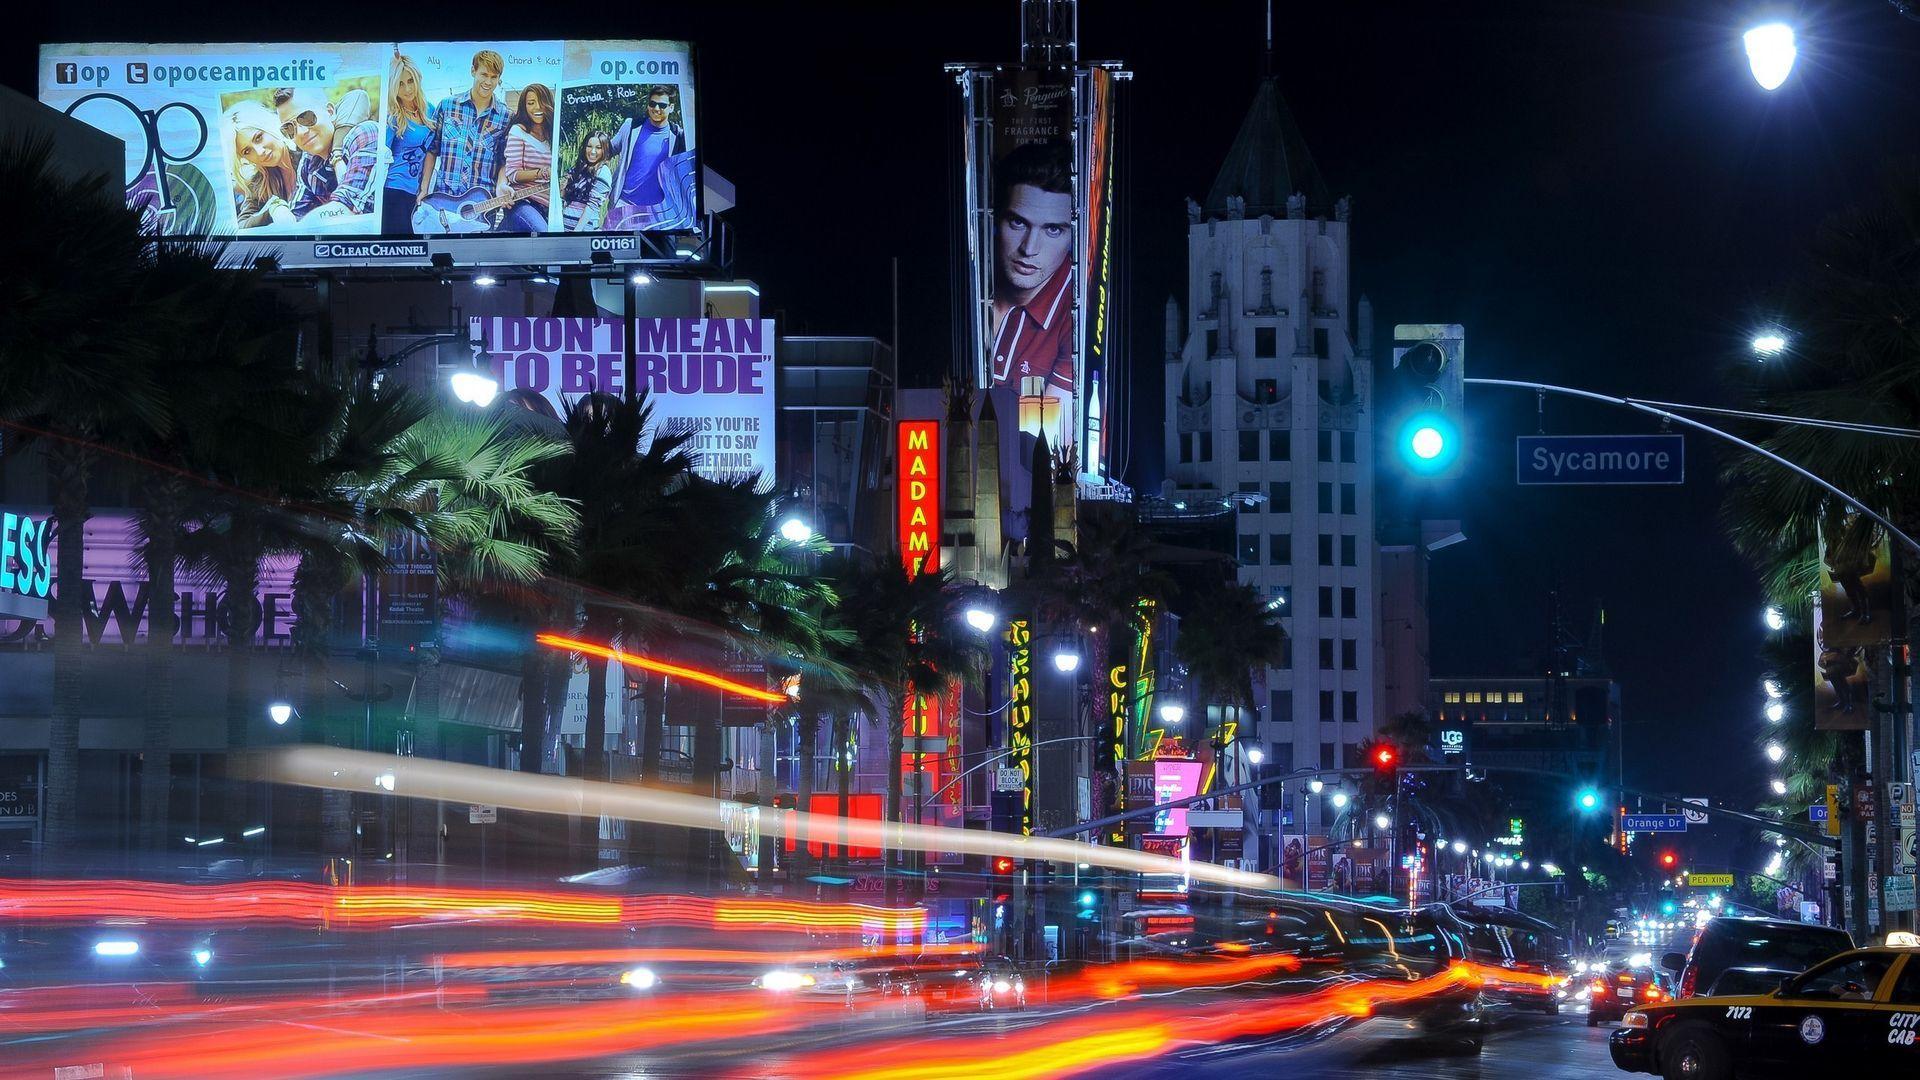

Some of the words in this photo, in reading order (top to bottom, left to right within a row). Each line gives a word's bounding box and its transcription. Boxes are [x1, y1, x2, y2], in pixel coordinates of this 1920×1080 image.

[427, 55, 442, 69] Aly
[508, 54, 533, 65] Chord
[153, 60, 326, 87] opoceanpacific
[600, 58, 680, 80] op.com
[81, 66, 110, 87] op
[566, 92, 604, 105] Brenda
[616, 87, 636, 99] Rob
[1023, 86, 1069, 105] Penguin
[1004, 126, 1059, 135] FRAGRANCE
[591, 238, 635, 249] 001161
[502, 317, 625, 352] DON'T
[638, 318, 763, 353] MEAN
[561, 353, 625, 394] BE
[715, 417, 760, 431] YOU'RE
[715, 435, 732, 449] TO
[735, 435, 759, 449] SAY
[1532, 447, 1670, 476] Sycamore
[1441, 731, 1463, 745] UGG
[1627, 818, 1664, 829] Orange
[1669, 818, 1680, 826] Dr
[1726, 1006, 1752, 1019] 7172
[1889, 1013, 1920, 1027] CITY
[1887, 1029, 1915, 1045] CAB
